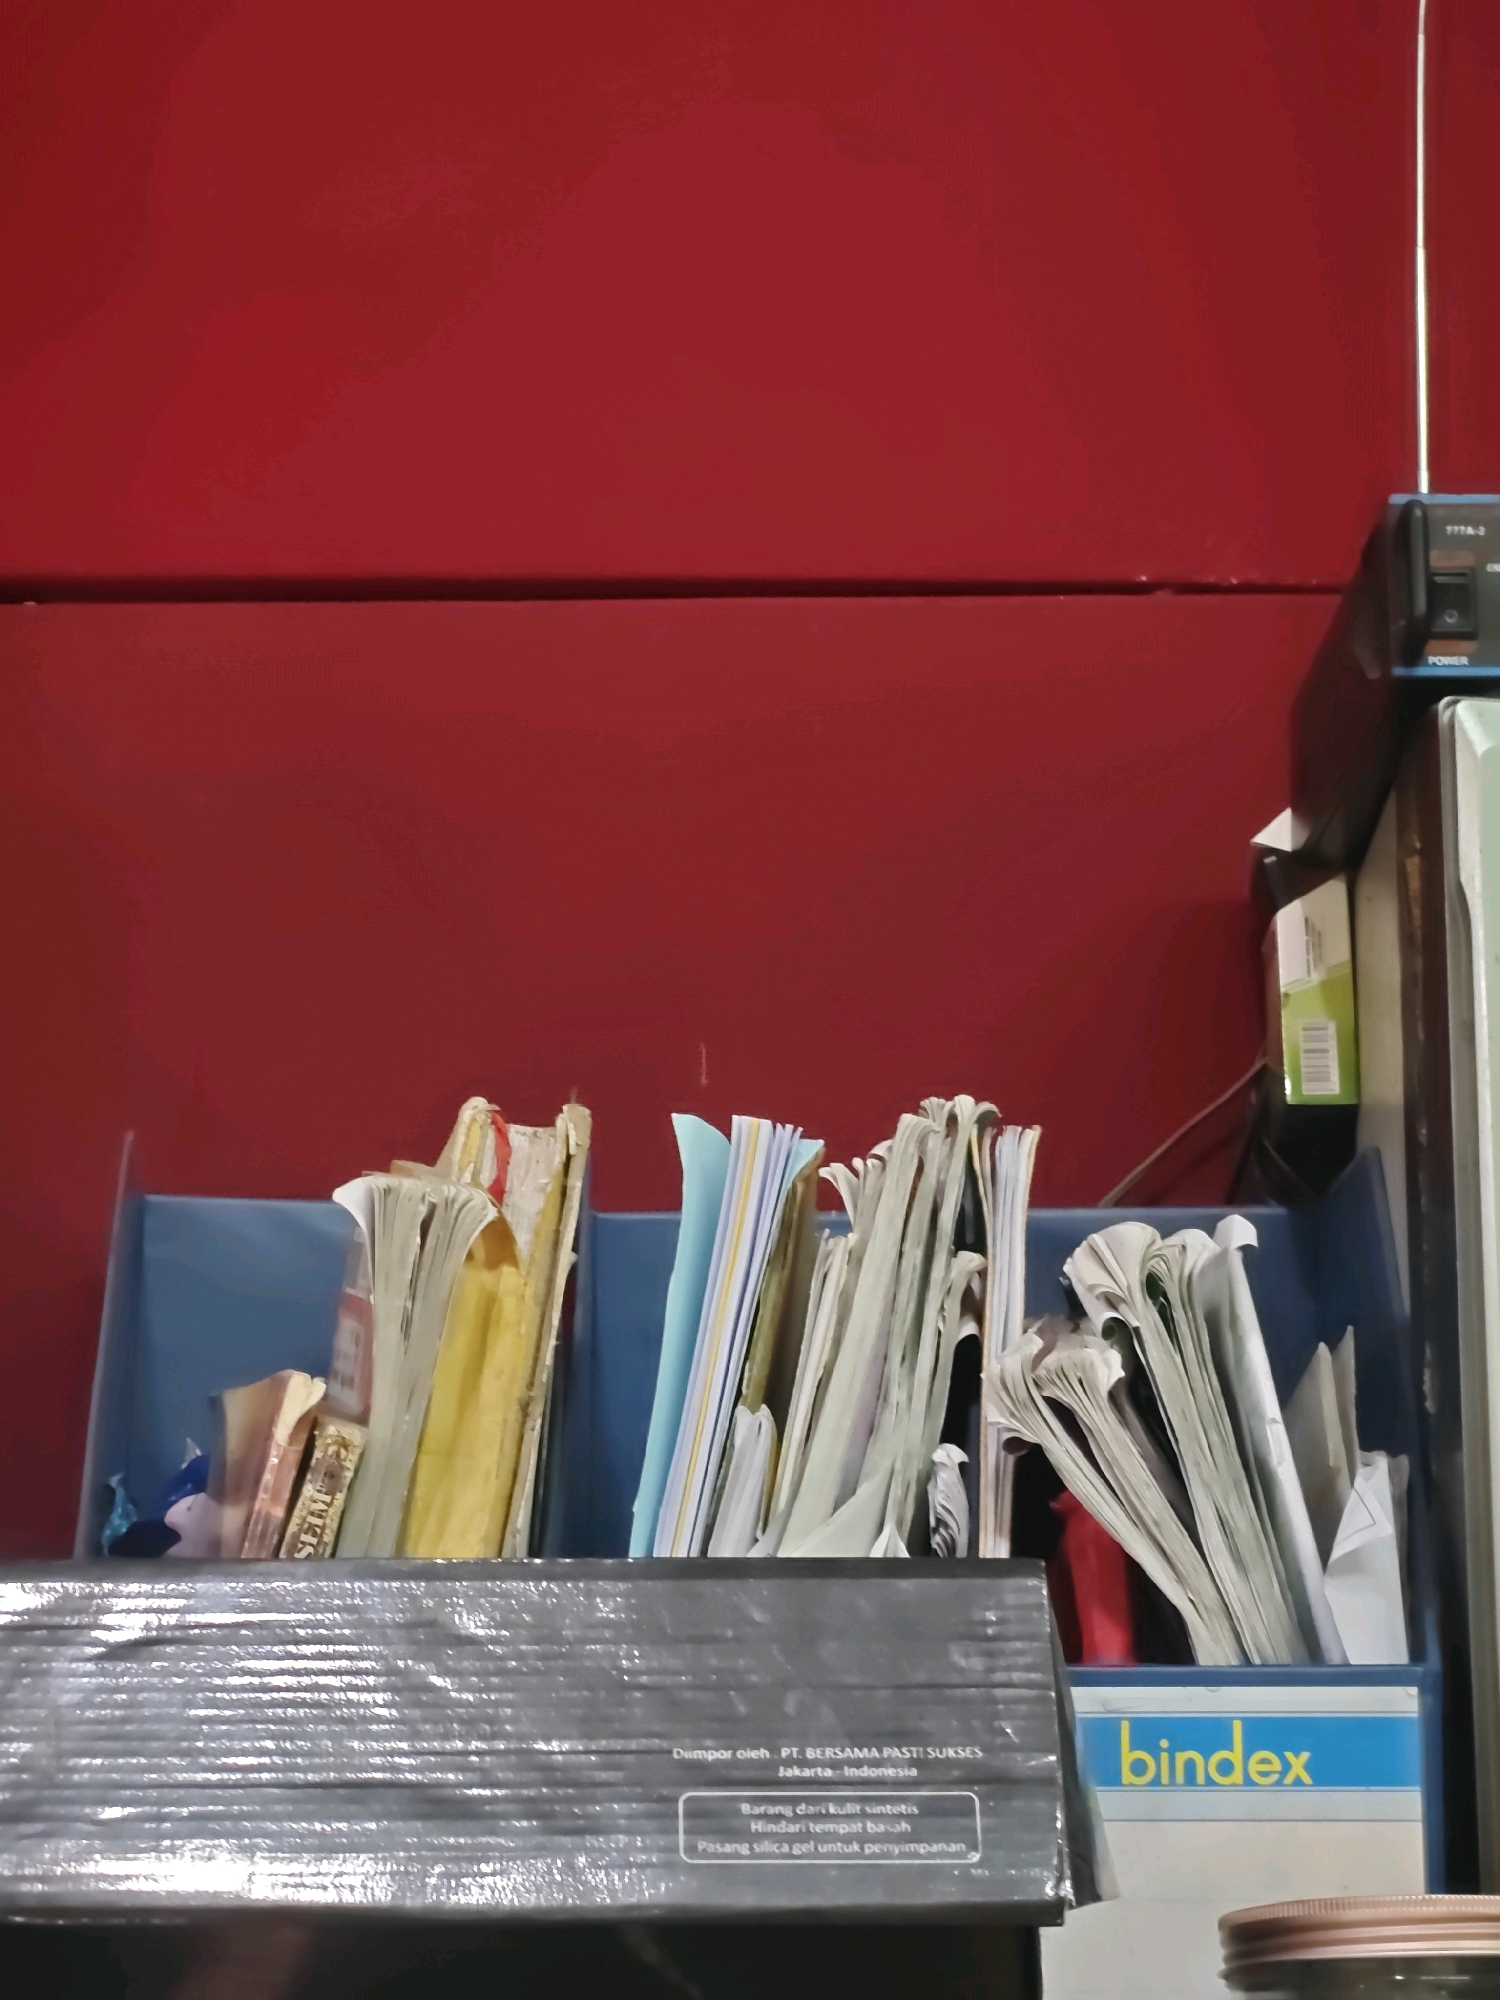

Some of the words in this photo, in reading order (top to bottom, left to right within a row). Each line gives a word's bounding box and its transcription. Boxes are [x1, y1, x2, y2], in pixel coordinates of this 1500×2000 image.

[1428, 656, 1469, 666] POWER
[736, 1747, 770, 1759] oleh
[781, 1747, 803, 1759] PT.
[805, 1747, 880, 1759] BERSAMA
[882, 1747, 924, 1759] PASTI
[926, 1746, 983, 1759] SUKSES
[1120, 1719, 1313, 1785] bindex
[778, 1765, 833, 1777] Jakarta
[843, 1764, 918, 1777] Indonesia
[740, 1803, 793, 1817] Barang
[795, 1803, 826, 1815] dari
[828, 1803, 861, 1815] kulit
[864, 1804, 919, 1815] sintetis
[750, 1820, 806, 1833] Hindari
[808, 1822, 863, 1835] tempat
[865, 1820, 911, 1833] basah
[697, 1840, 750, 1855] Pasang
[752, 1840, 789, 1853] silica
[792, 1840, 814, 1855] gel
[817, 1841, 861, 1853] untuk
[864, 1842, 966, 1856] penyimpanan
